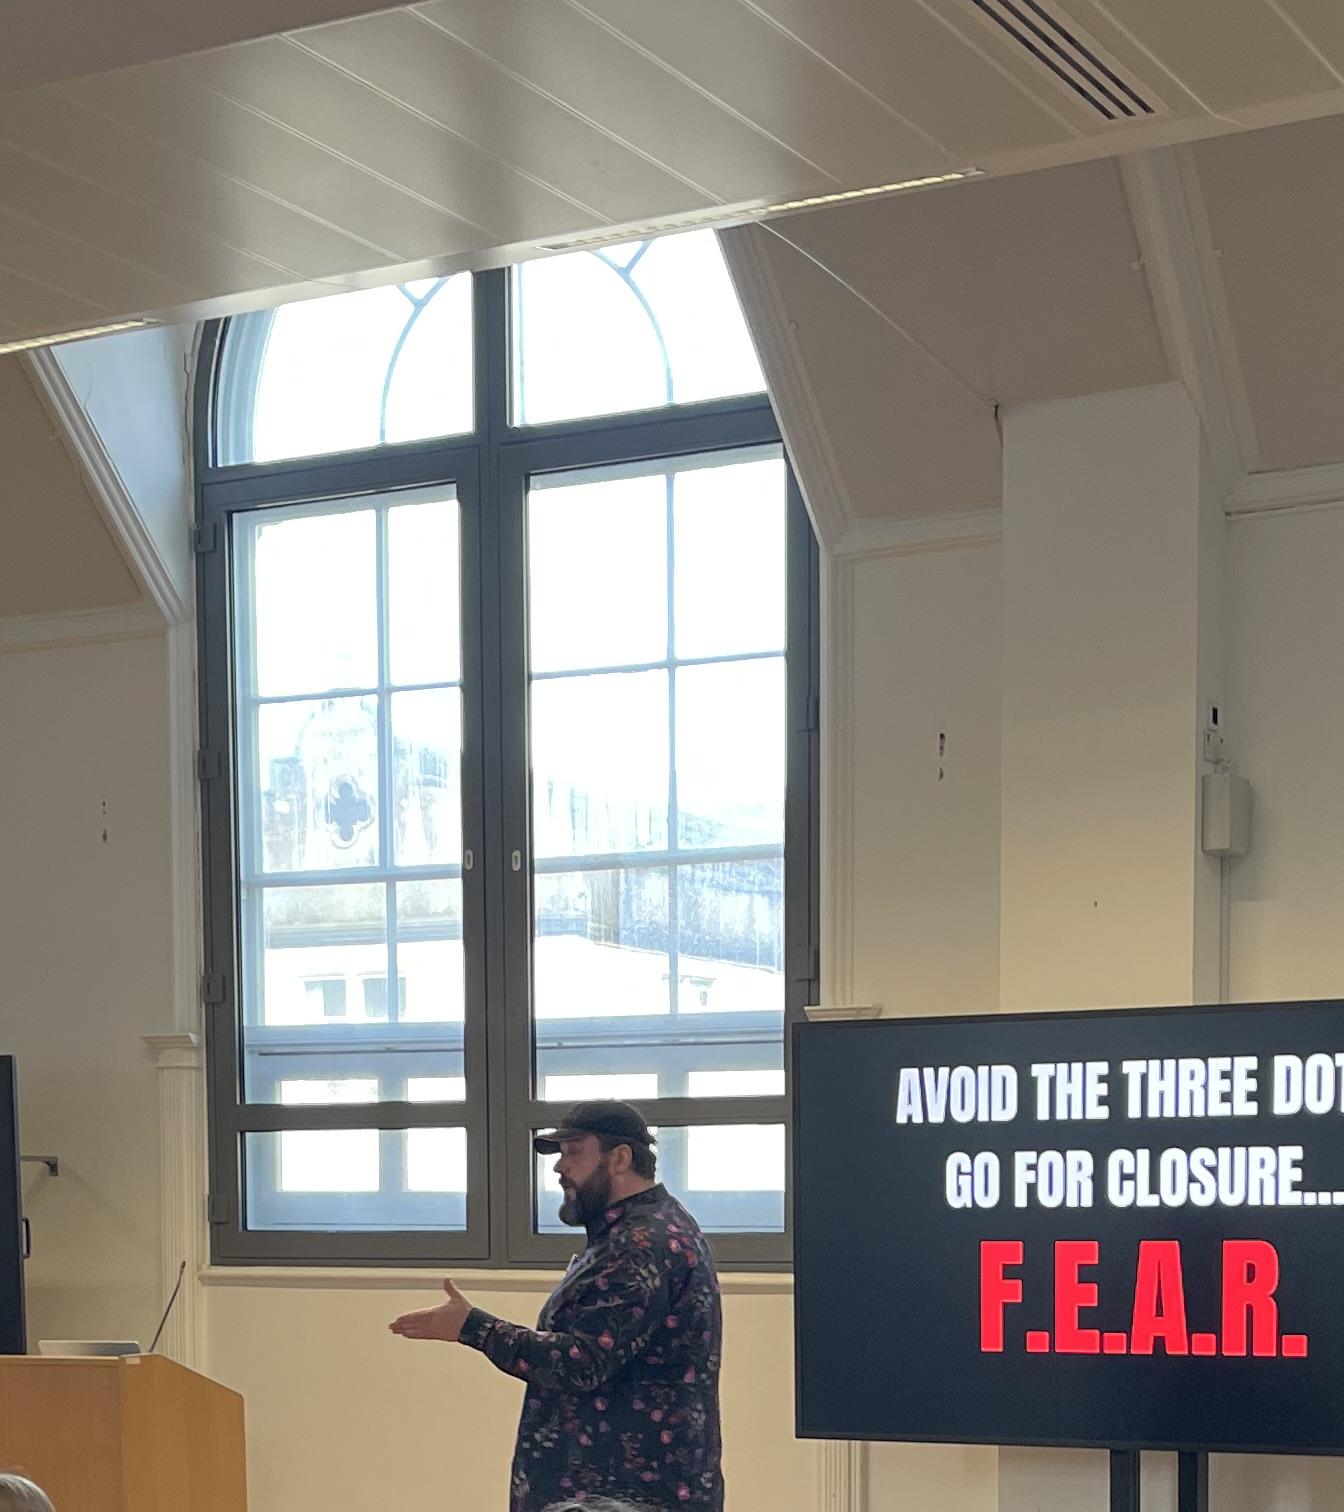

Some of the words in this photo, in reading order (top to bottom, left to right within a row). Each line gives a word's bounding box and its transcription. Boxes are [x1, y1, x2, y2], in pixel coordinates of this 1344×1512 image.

[896, 1064, 1018, 1125] AVOID
[1030, 1060, 1110, 1122] THE
[1120, 1055, 1259, 1119] THREE
[945, 1151, 1001, 1209] GO
[1014, 1149, 1094, 1209] FOR
[979, 1240, 1309, 1359] F.E.A.R.
